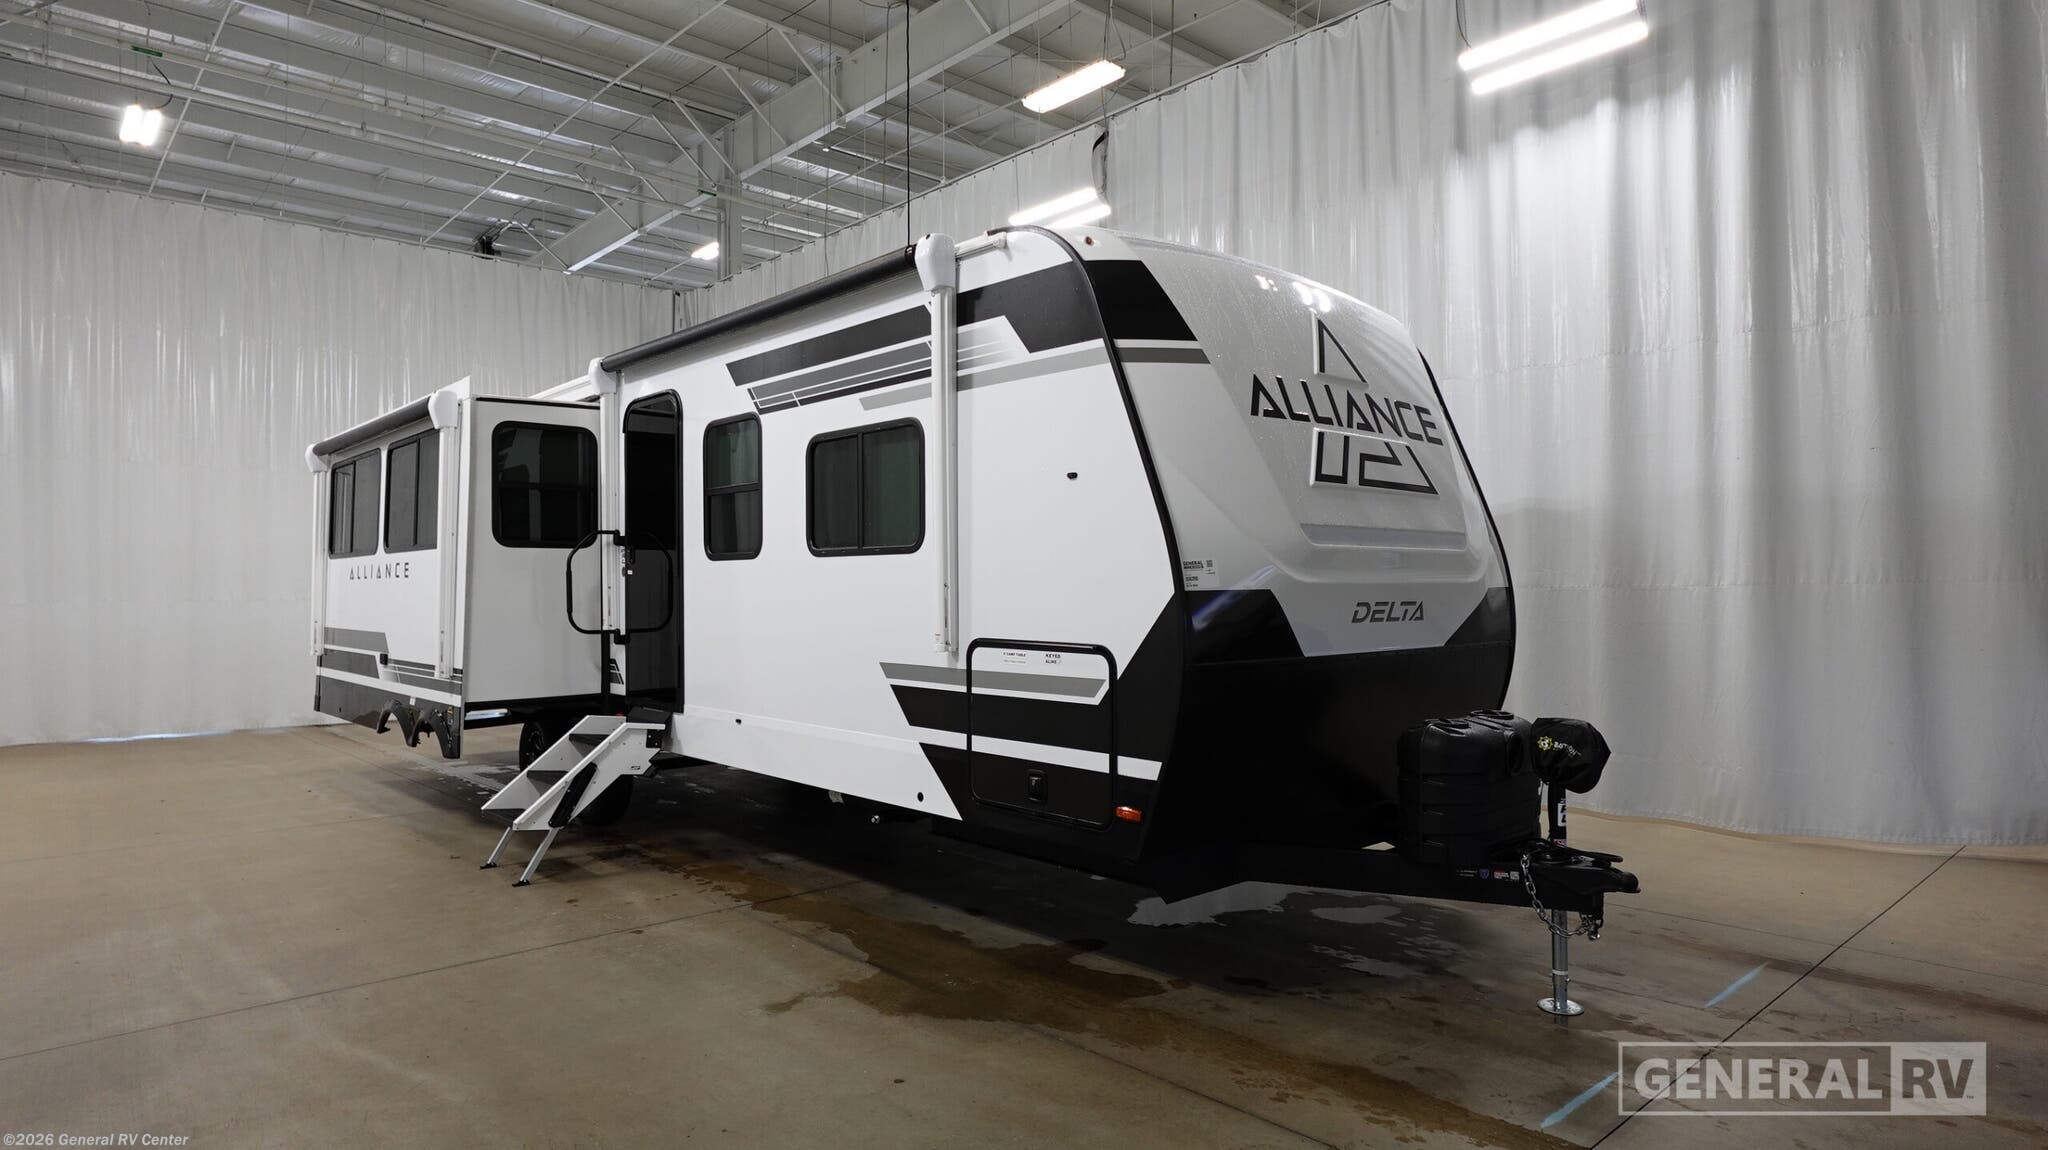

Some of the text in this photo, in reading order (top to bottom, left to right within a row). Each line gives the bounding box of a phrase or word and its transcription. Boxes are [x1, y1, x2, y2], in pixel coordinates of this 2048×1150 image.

[1250, 373, 1444, 446] ALLIANCE
[349, 562, 410, 580] ALLIANCE
[1351, 600, 1425, 623] DELTA
